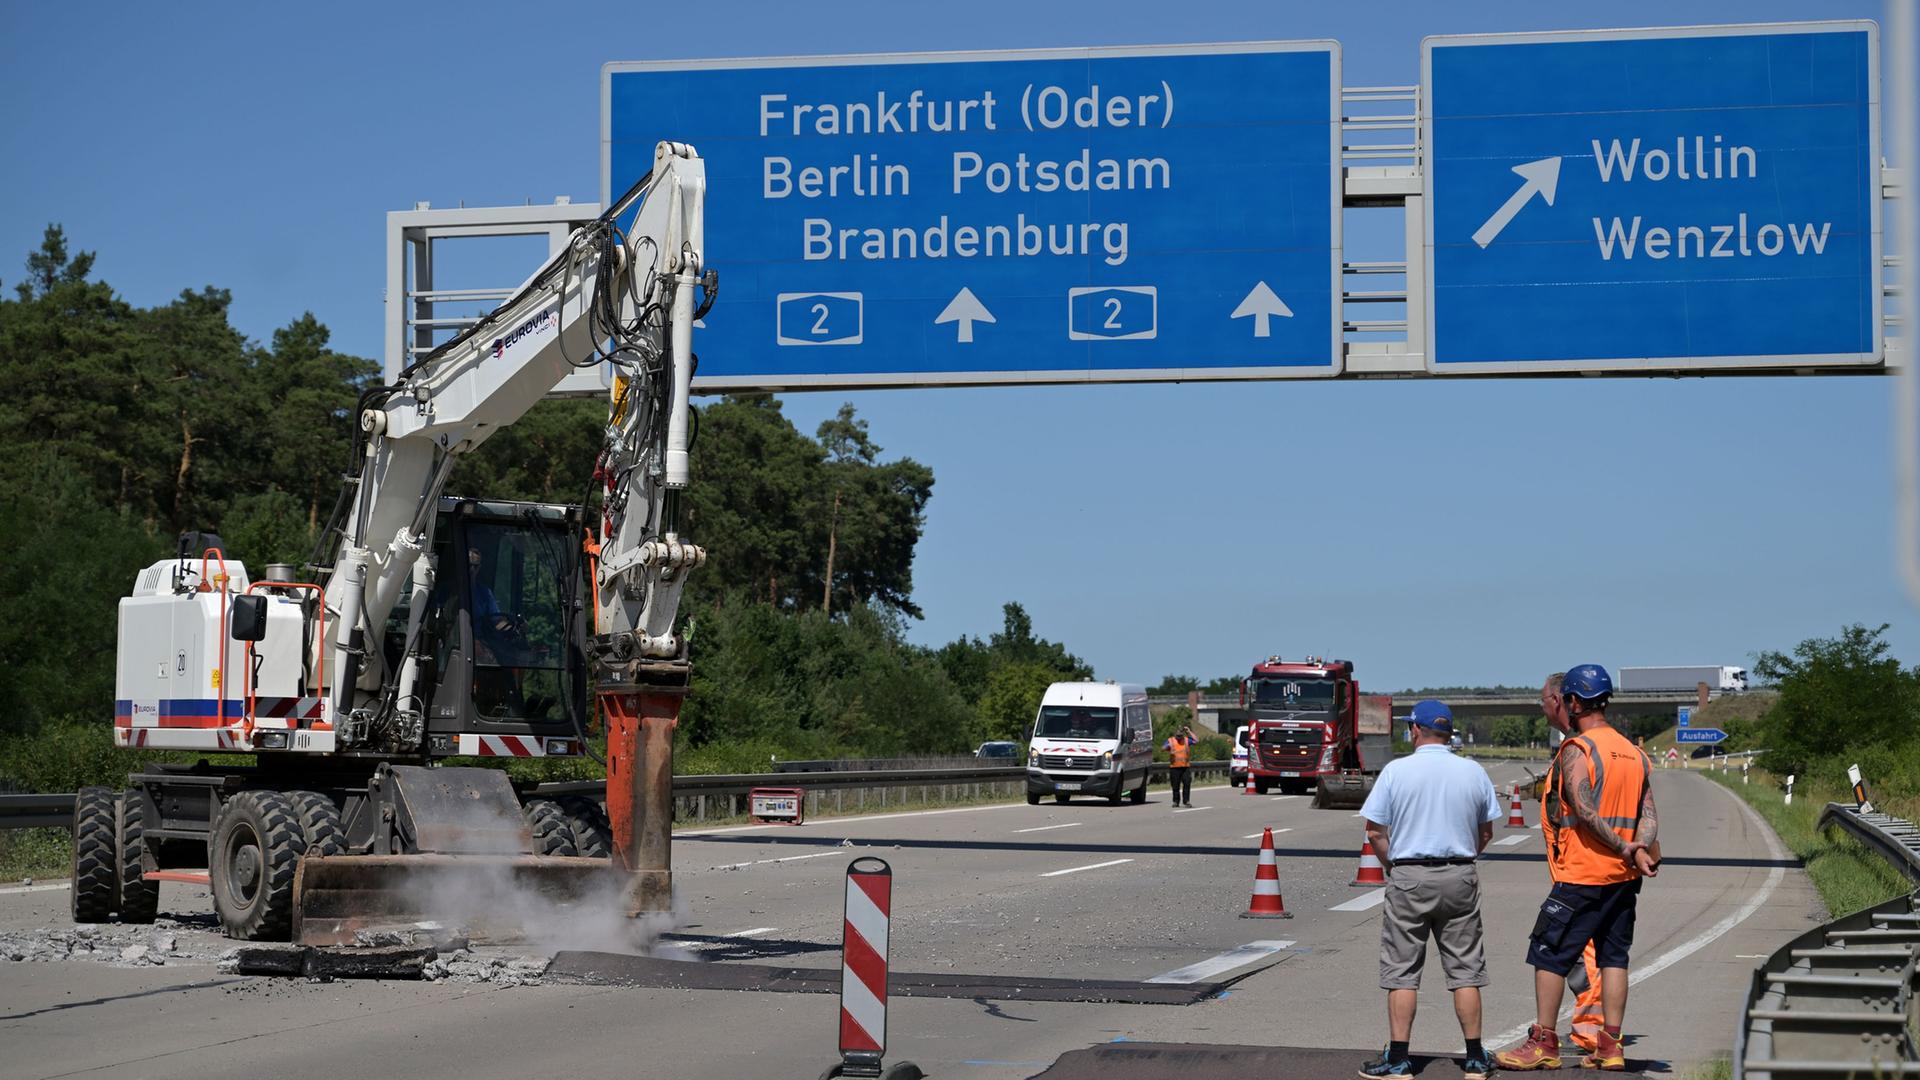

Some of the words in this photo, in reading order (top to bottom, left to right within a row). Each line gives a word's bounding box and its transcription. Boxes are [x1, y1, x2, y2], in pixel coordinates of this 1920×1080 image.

[759, 90, 997, 137] Frankfurt
[1020, 80, 1175, 132] (Oder)
[763, 154, 910, 199] Berlin
[952, 148, 1171, 194] Potsdam
[1591, 135, 1757, 183] Wollin
[803, 213, 1129, 266] Brandenburg
[1592, 212, 1832, 261] Wenzlow
[505, 310, 550, 349] EUROVIA
[810, 303, 829, 335] 2
[1103, 297, 1122, 329] 2
[1682, 732, 1718, 740] Ausfahrt
